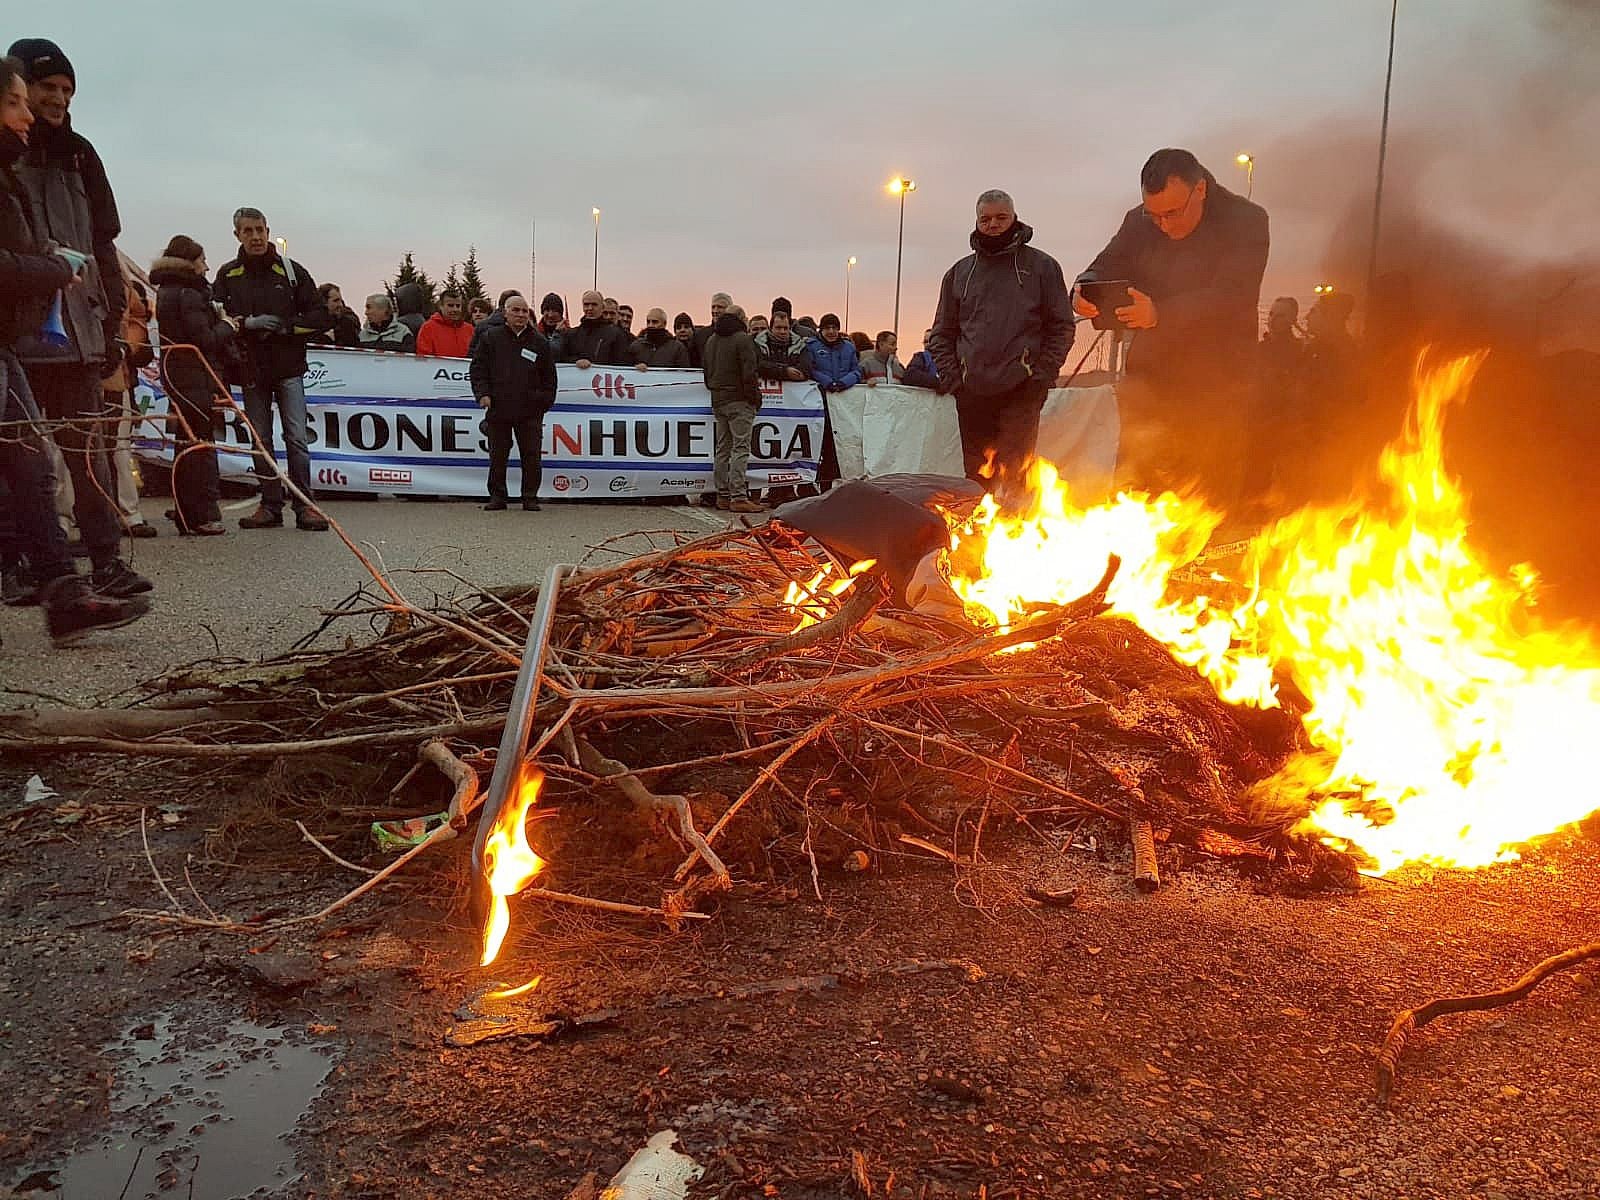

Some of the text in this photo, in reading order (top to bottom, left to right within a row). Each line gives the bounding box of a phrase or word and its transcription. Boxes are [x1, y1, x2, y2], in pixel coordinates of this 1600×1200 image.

[433, 368, 472, 381] Aca
[592, 373, 636, 400] CIG
[589, 420, 813, 460] HUEGA
